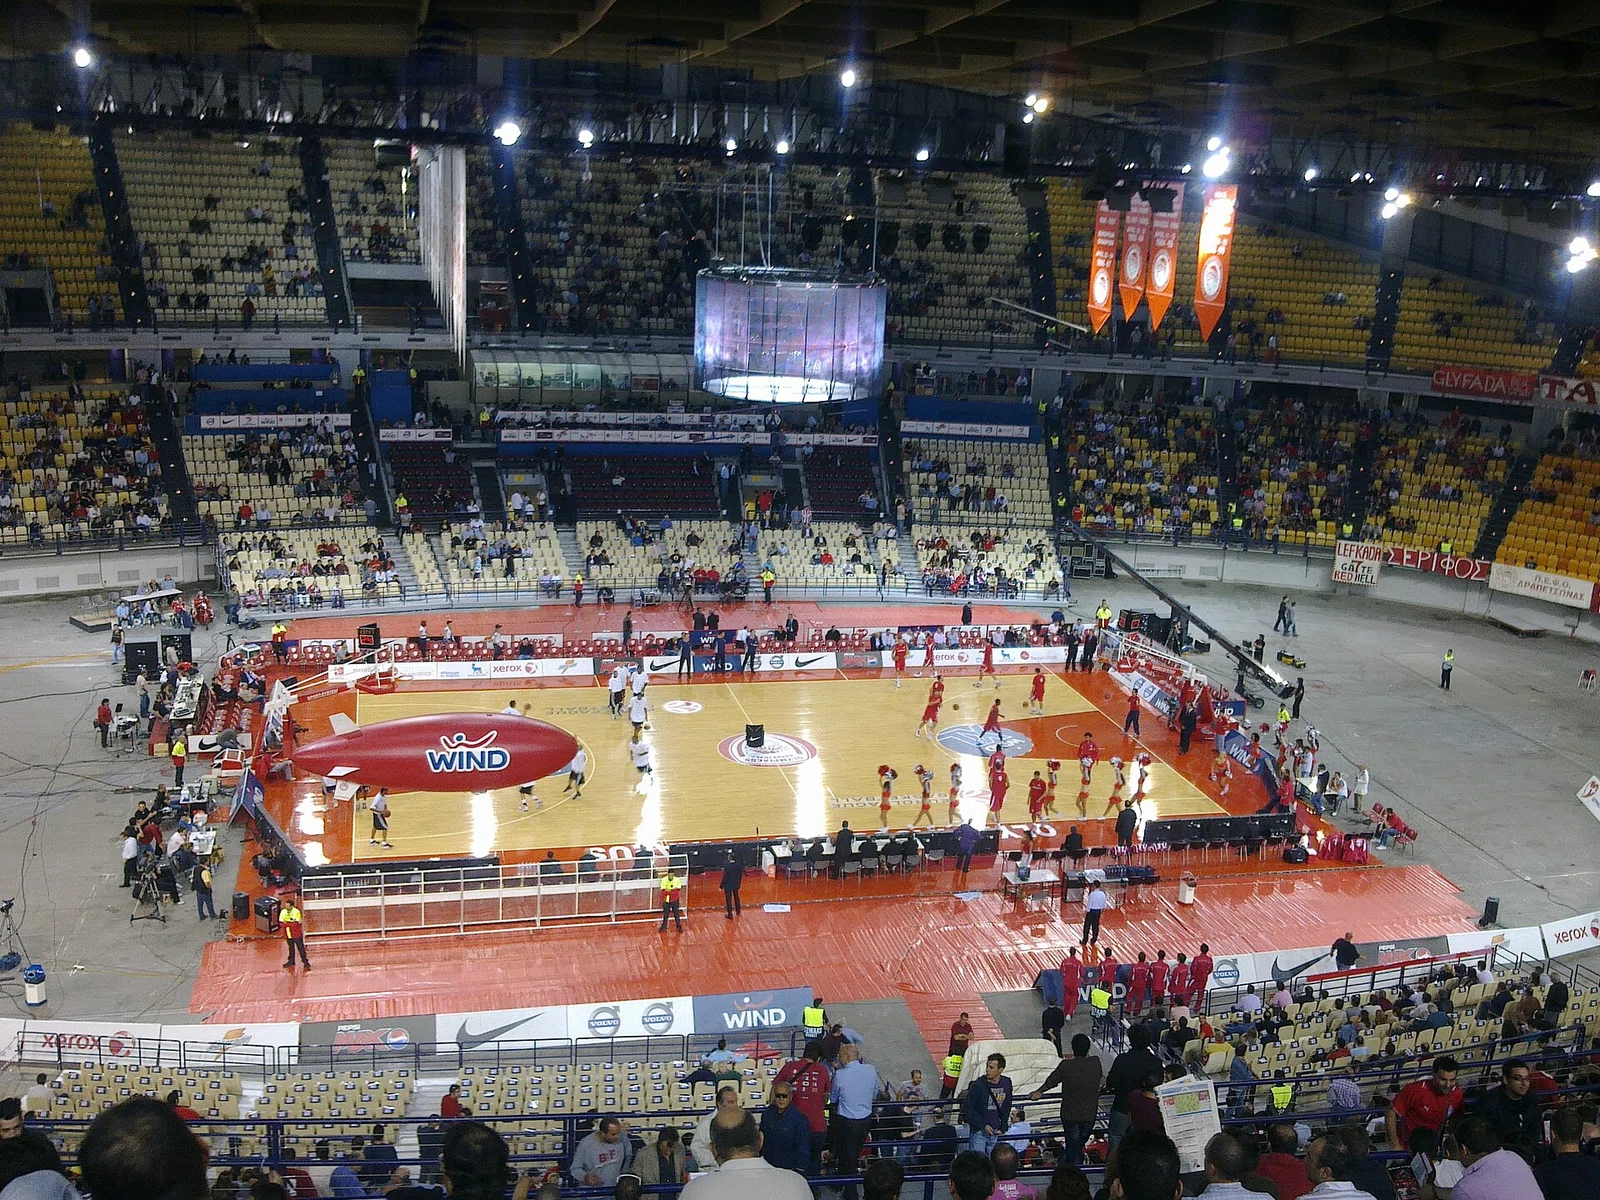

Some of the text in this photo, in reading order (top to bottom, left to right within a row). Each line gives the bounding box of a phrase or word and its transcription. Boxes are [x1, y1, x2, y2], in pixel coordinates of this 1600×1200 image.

[1433, 370, 1507, 395] GLYFADA
[1337, 542, 1382, 562] LEFKADA
[1334, 570, 1376, 585] RED HELL
[493, 664, 522, 673] xerox
[427, 748, 510, 772] WIND
[1554, 926, 1588, 945] xerox
[722, 1008, 786, 1029] WIND
[41, 1033, 100, 1050] xerox
